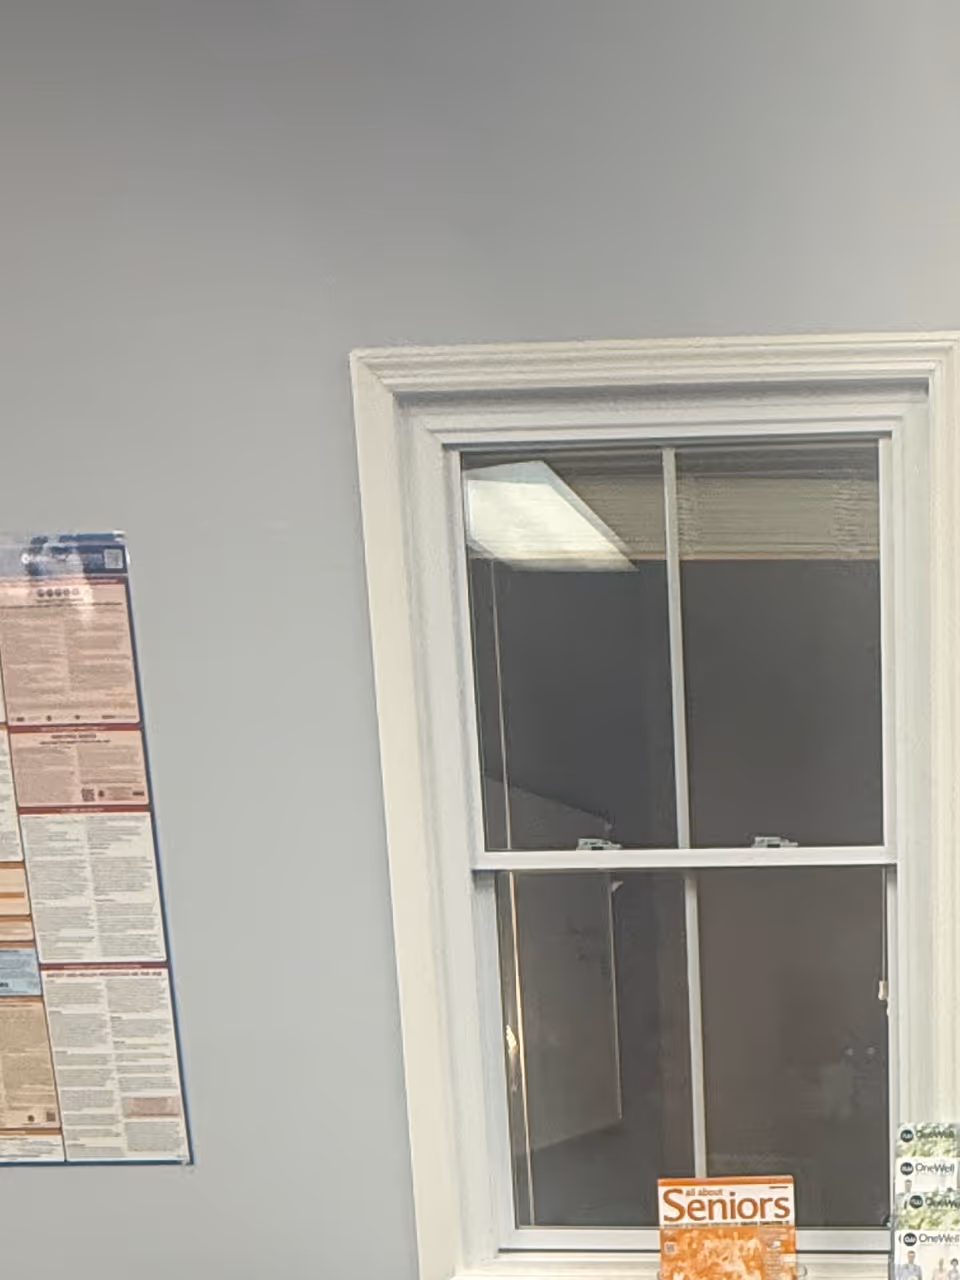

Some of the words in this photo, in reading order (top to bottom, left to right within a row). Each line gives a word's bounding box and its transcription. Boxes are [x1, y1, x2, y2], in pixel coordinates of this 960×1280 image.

[915, 1162, 955, 1173] OneWell
[685, 1188, 696, 1197] all
[698, 1188, 723, 1197] about
[662, 1188, 791, 1222] Seniors
[918, 1233, 960, 1243] OneWell
